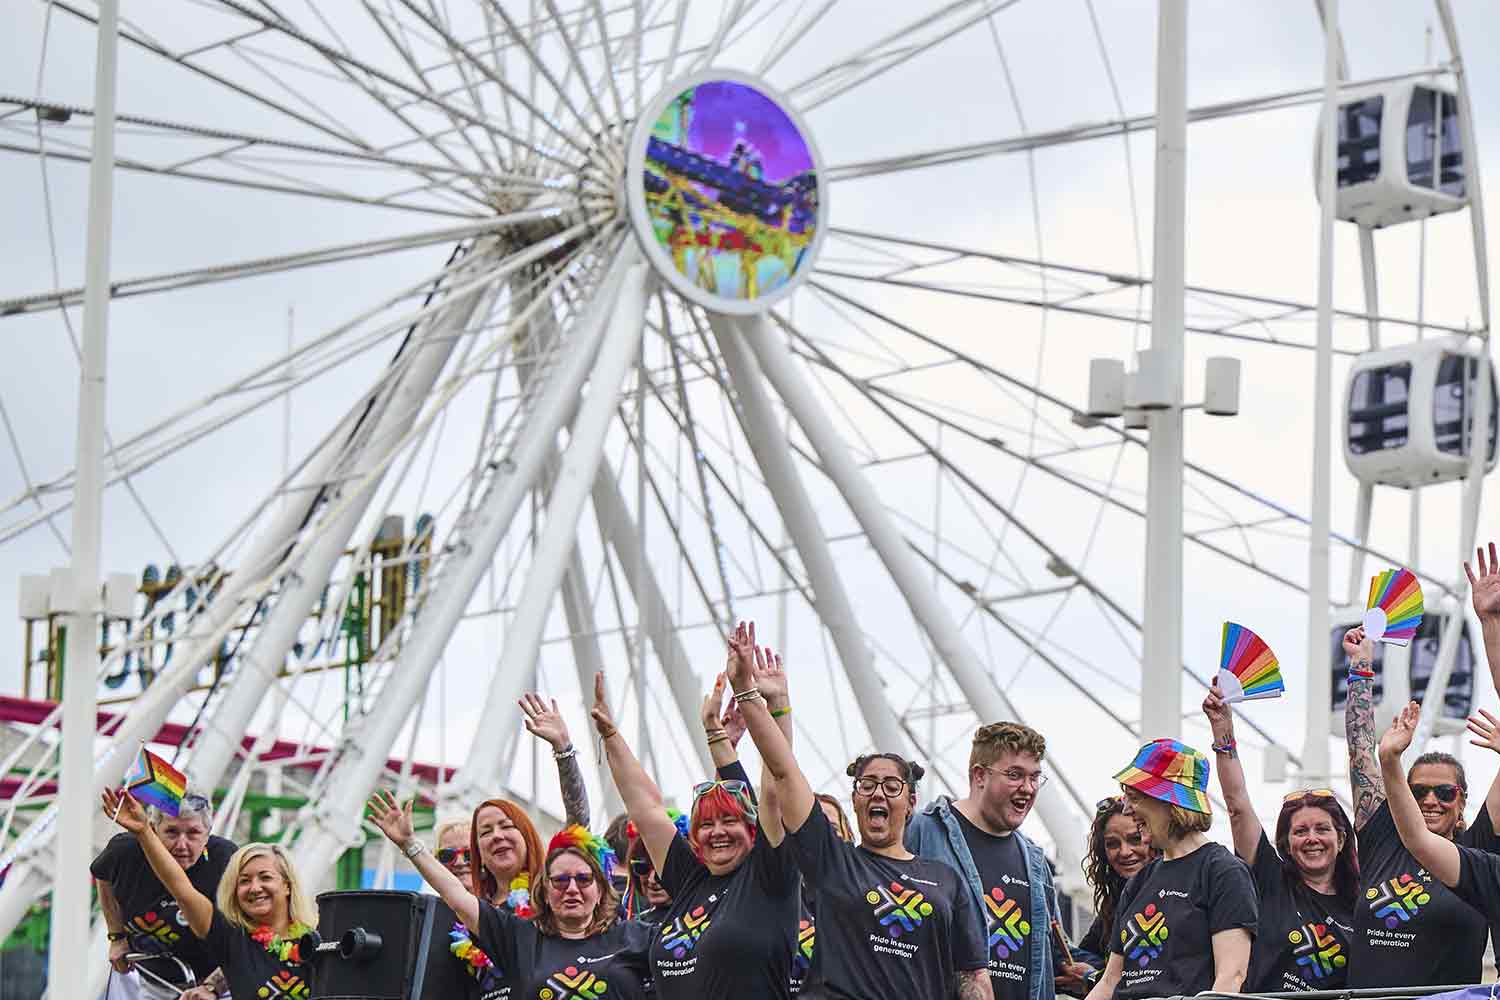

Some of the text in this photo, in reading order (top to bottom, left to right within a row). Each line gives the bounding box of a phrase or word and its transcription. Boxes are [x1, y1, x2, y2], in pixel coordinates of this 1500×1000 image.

[1367, 929, 1416, 941] Pride in every
[870, 934, 919, 953] Pride in every
[1370, 938, 1410, 948] generation
[873, 944, 913, 959] generation
[657, 960, 674, 968] Pride
[1007, 963, 1027, 975] every
